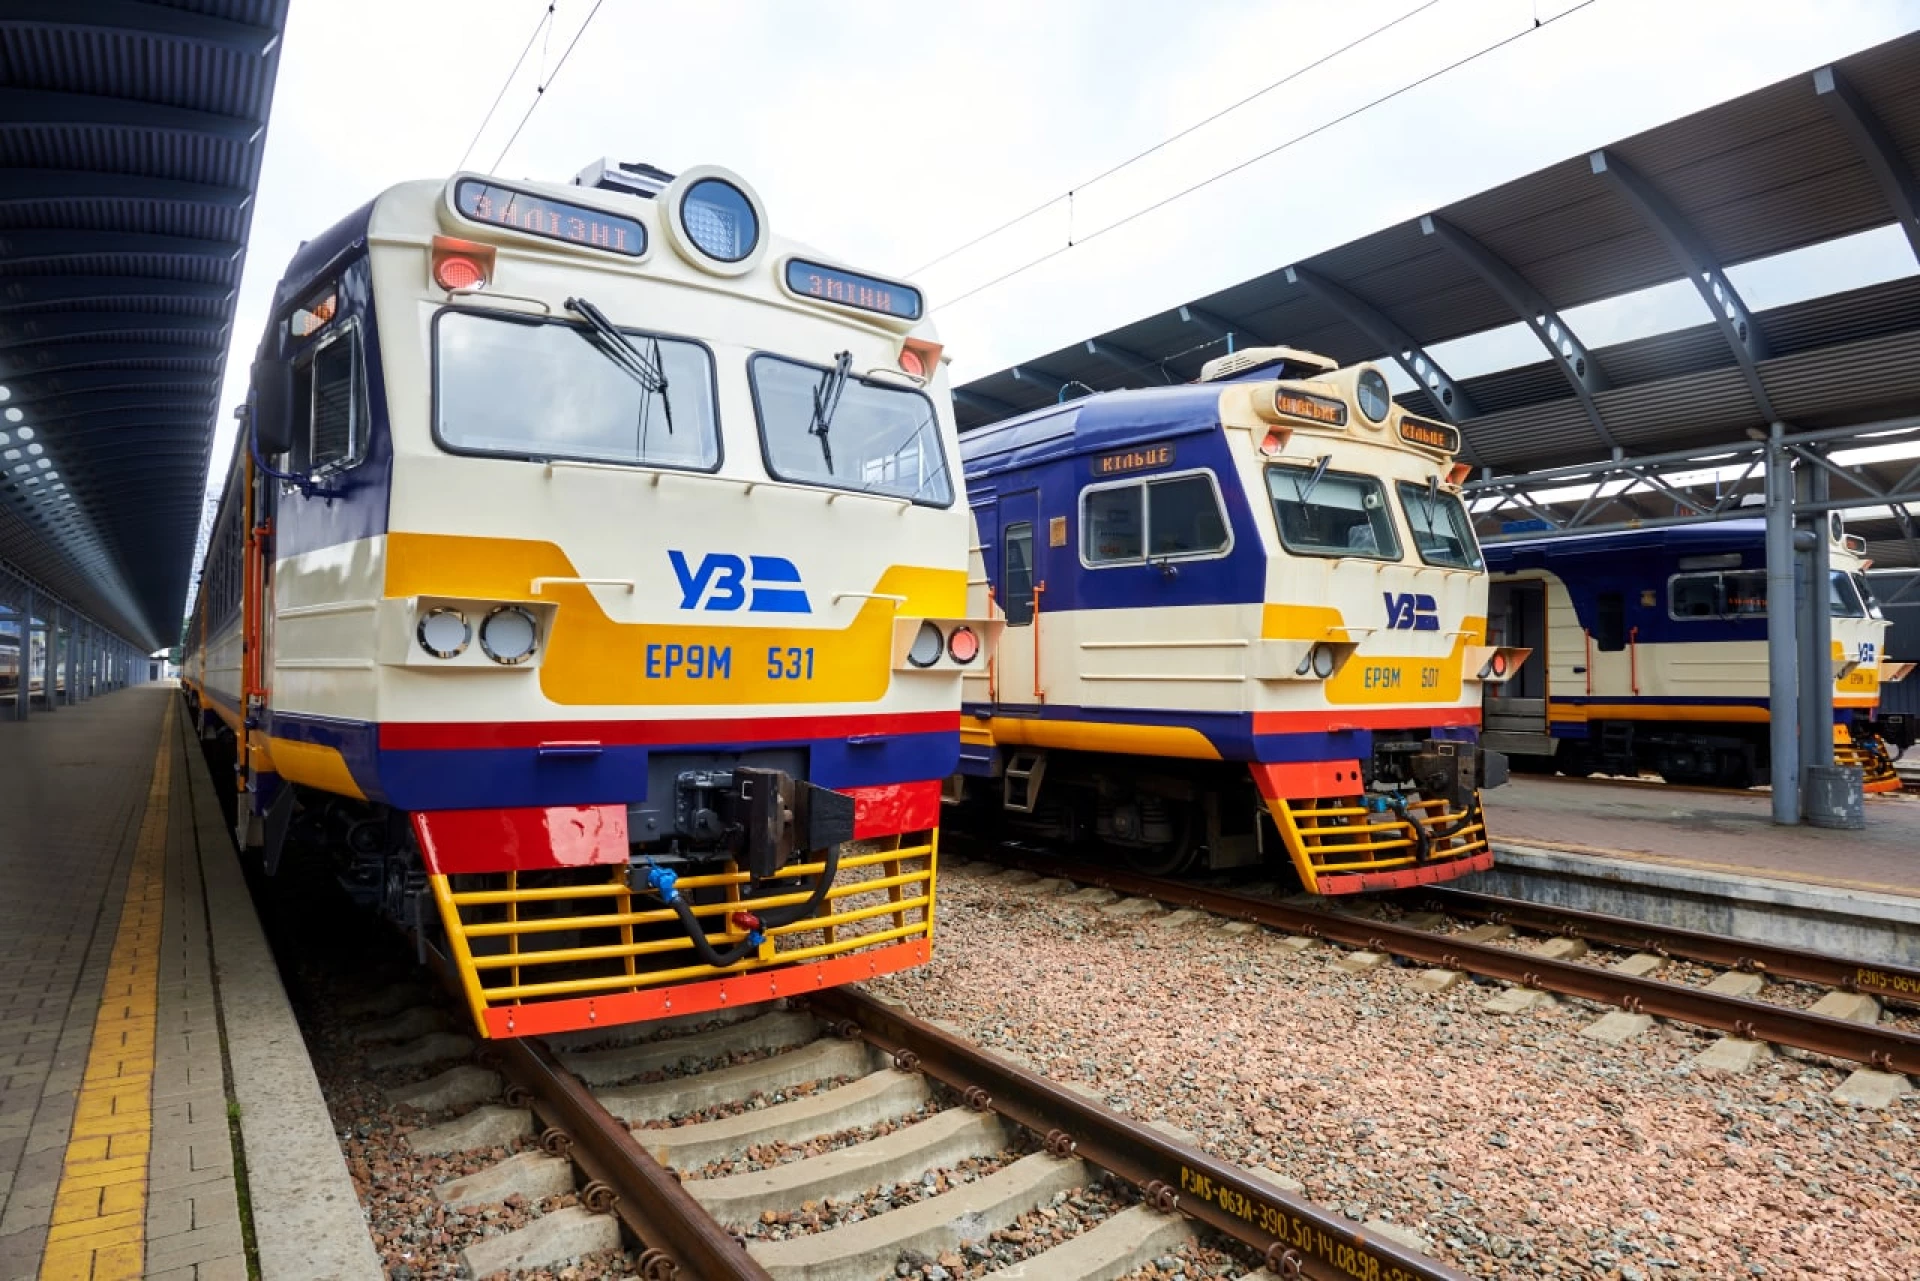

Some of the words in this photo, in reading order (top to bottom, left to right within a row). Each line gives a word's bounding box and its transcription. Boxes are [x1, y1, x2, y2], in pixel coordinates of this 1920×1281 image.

[1103, 447, 1168, 472] КІЛЬЦЕ
[667, 550, 746, 611] УЗ
[767, 647, 814, 680] 531
